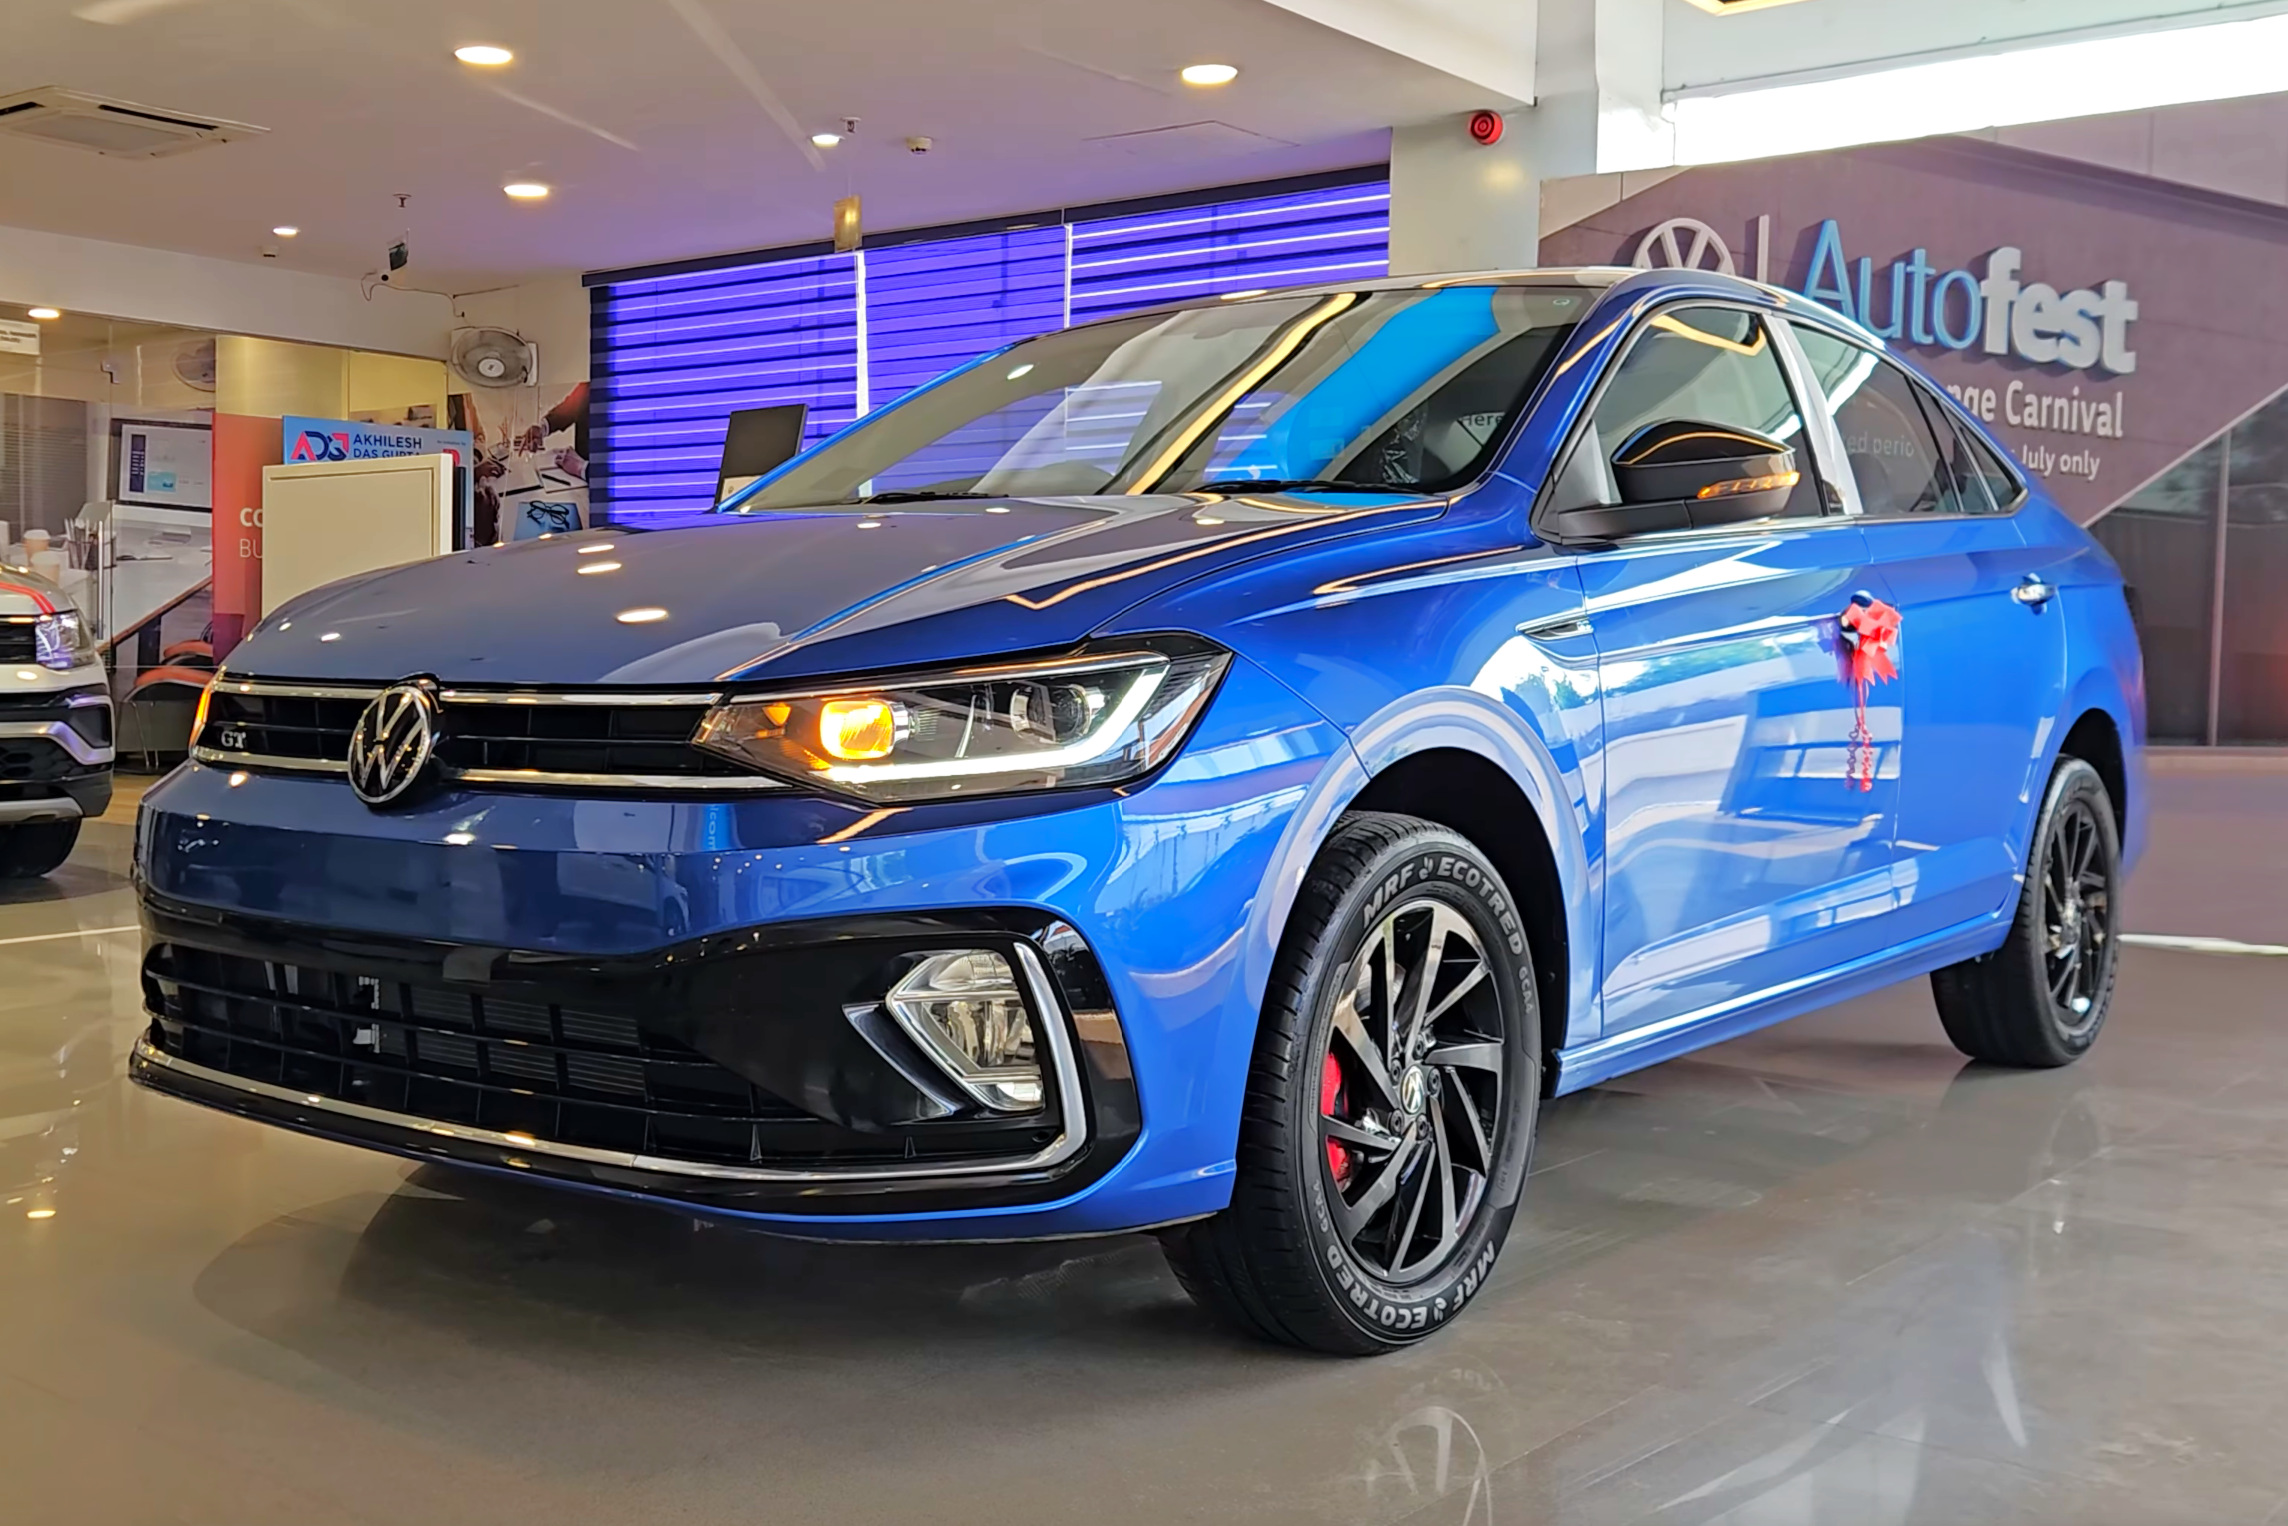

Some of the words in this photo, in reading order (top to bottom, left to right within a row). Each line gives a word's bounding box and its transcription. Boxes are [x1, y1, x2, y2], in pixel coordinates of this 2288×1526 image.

[1804, 218, 2139, 375] Autofest
[2005, 379, 2124, 438] Carnival
[353, 433, 422, 449] AKHILESH
[353, 448, 379, 459] DAS
[2059, 449, 2100, 482] only
[220, 730, 247, 749] GT
[1363, 862, 1415, 930] MRF
[1436, 856, 1524, 955] ECOTRED
[1325, 1244, 1428, 1330] ECOTRED
[1452, 1240, 1495, 1312] MRF
